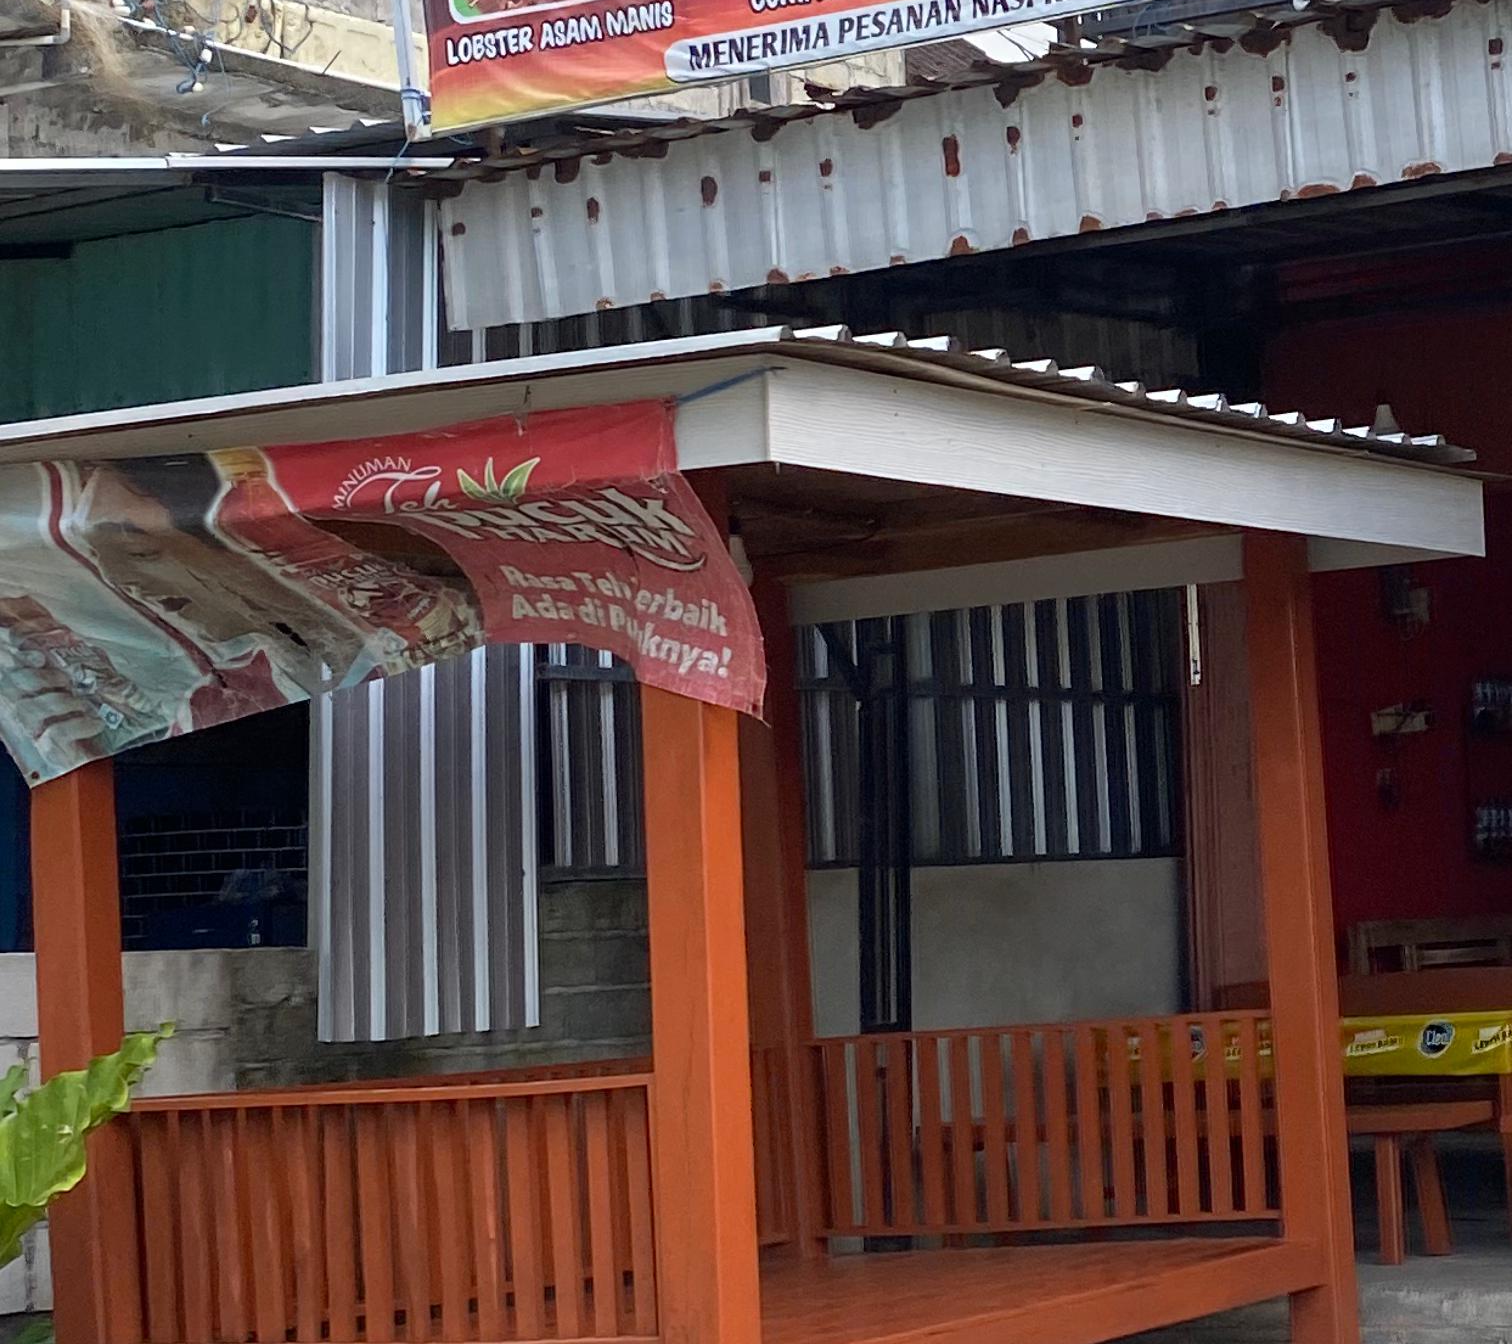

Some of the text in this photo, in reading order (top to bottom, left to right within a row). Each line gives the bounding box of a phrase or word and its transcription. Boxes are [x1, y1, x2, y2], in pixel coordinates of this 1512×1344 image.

[446, 0, 675, 66] LOBSTER ASAM MANIS
[688, 26, 830, 72] MENERIMA
[331, 455, 412, 511] MINUMAN
[345, 465, 457, 514] Teh
[486, 522, 694, 559] HARUM
[499, 565, 729, 637] Rasa Teh erbaik
[512, 593, 575, 620] Ada
[578, 596, 607, 628] di
